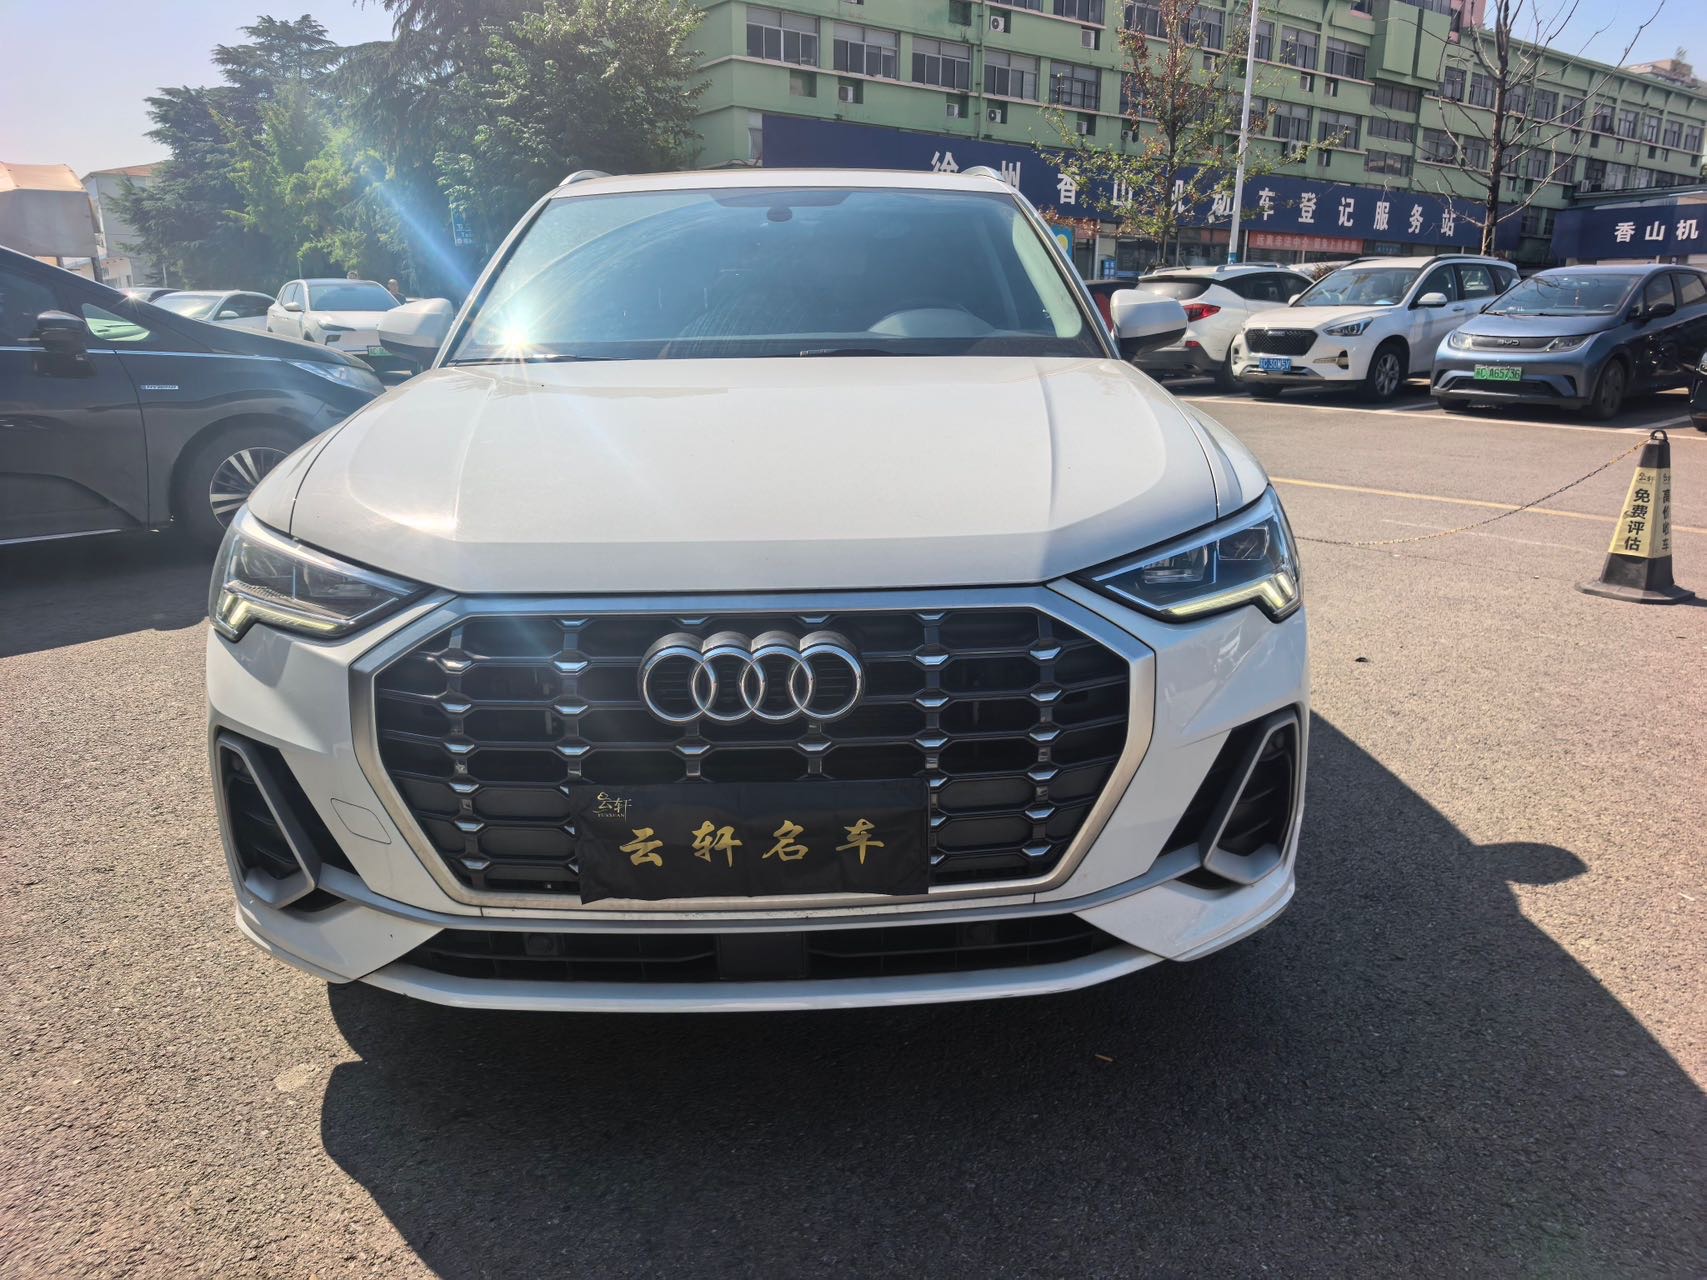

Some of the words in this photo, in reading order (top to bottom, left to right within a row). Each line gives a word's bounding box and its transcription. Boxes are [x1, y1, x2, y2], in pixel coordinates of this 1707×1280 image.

[1614, 219, 1699, 243] 香山机
[1624, 488, 1650, 551] 免费评估
[618, 819, 885, 868] 云轩名车
